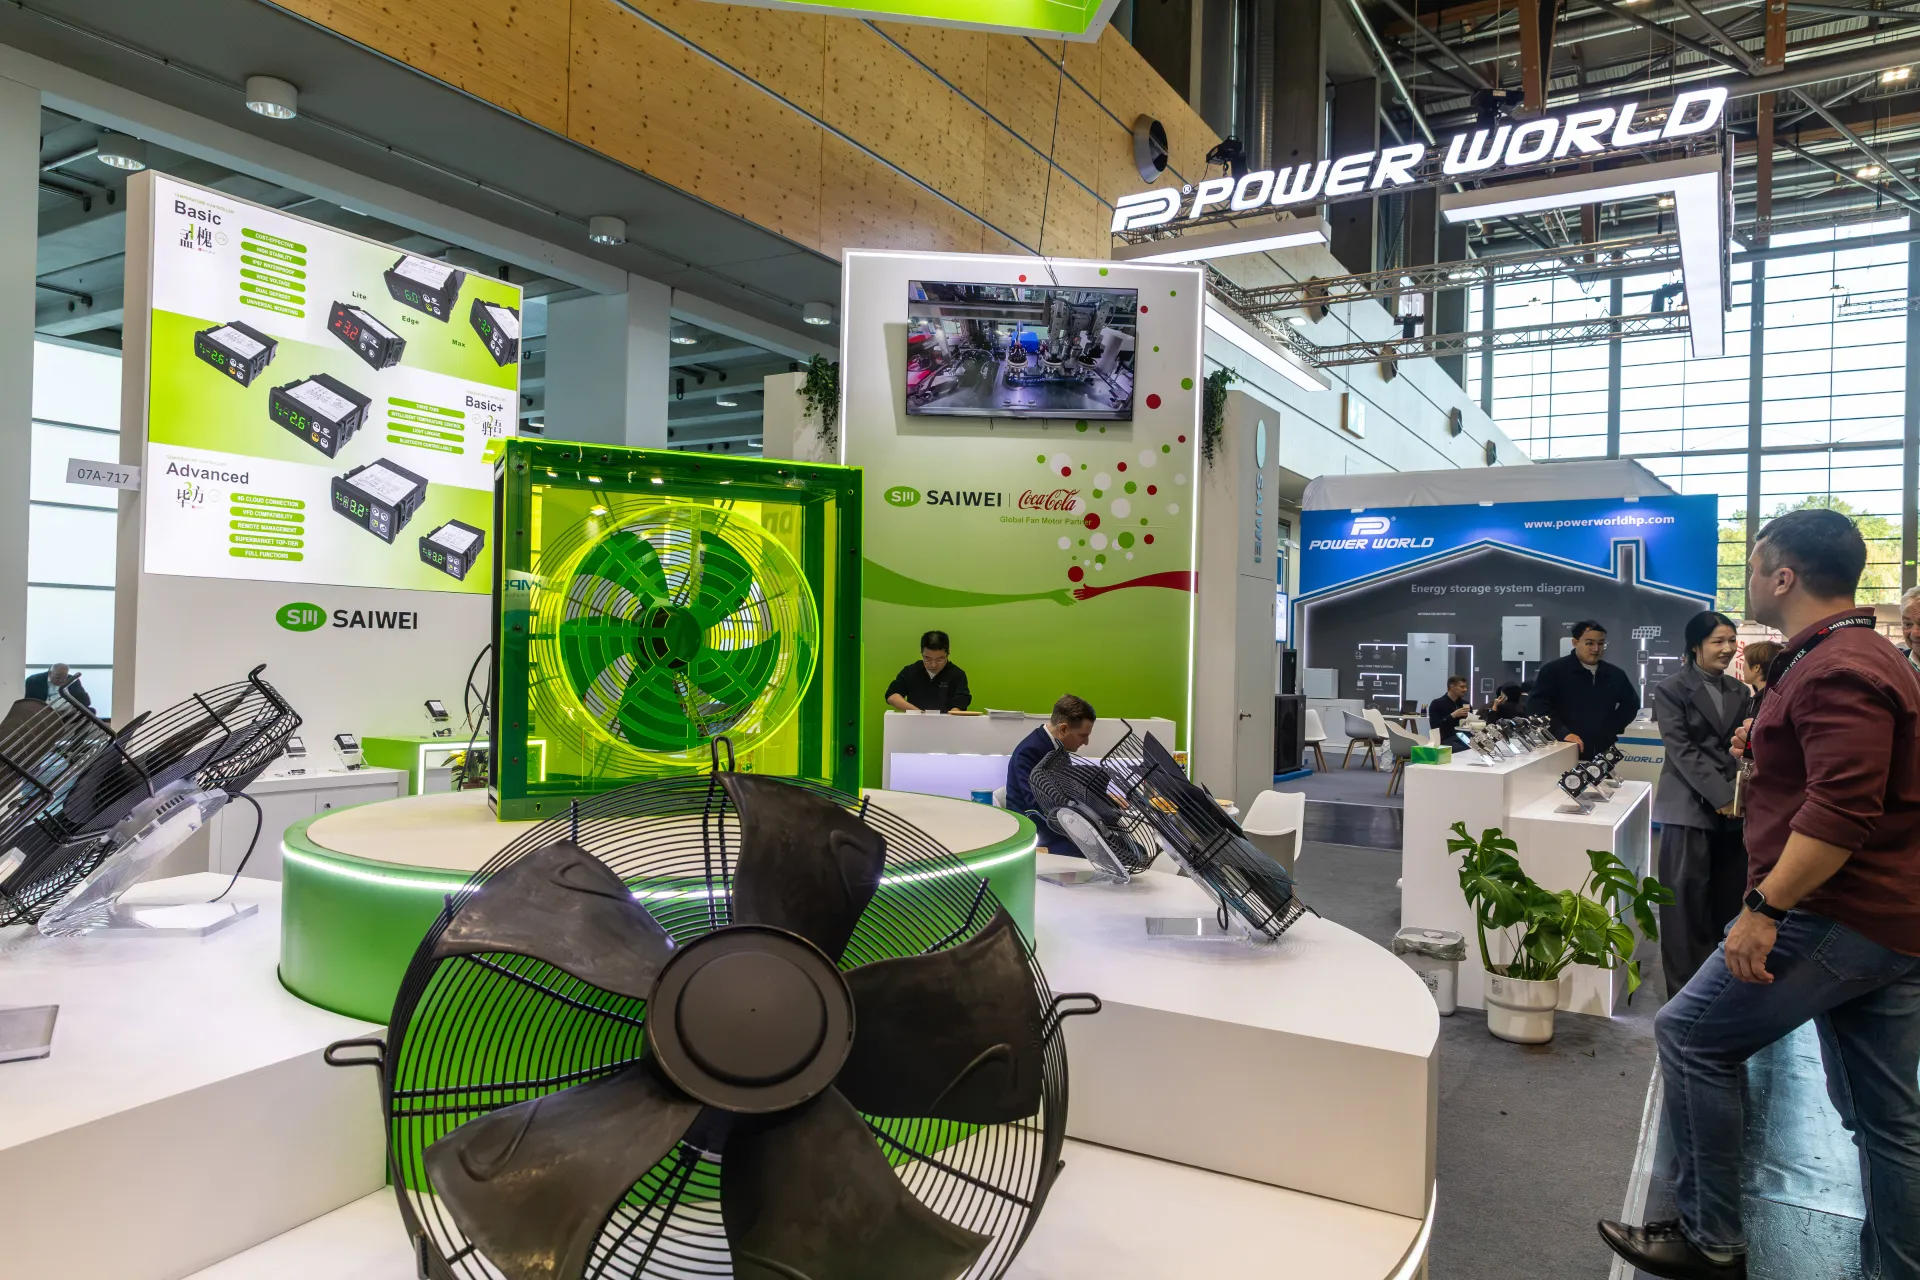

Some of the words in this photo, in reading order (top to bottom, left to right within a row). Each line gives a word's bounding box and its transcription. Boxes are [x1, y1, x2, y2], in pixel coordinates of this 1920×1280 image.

[1189, 143, 1425, 219] POWER
[1443, 87, 1728, 175] WORLD
[175, 199, 222, 225] Basic
[352, 291, 367, 300] Lite
[402, 315, 420, 325] Edge
[452, 339, 466, 348] Max
[465, 395, 504, 412] Basic+
[77, 468, 130, 484] 07A-717
[166, 462, 249, 485] Advanced
[926, 489, 1001, 507] SAIWEI
[1018, 488, 1081, 511] Coca-Cola
[237, 522, 260, 530] REMOTE
[999, 515, 1024, 524] Global
[1026, 516, 1040, 524] Fan
[1041, 517, 1062, 525] Motor
[1064, 517, 1093, 526] Partner
[1524, 515, 1675, 530] www.powerworldhp.com
[234, 535, 274, 544] SUPERMARKET
[1308, 538, 1369, 550] POWER
[1371, 537, 1435, 549] WORLD
[259, 551, 289, 559] FUNCTIONS
[1411, 584, 1447, 595] Energy
[1450, 584, 1491, 595] storage
[1494, 584, 1534, 595] system
[1536, 583, 1585, 594] diagram
[332, 609, 418, 630] SAIWEI
[1828, 618, 1855, 631] MIRAI
[1790, 648, 1807, 668] INTEX
[1624, 755, 1664, 764] WORLD
